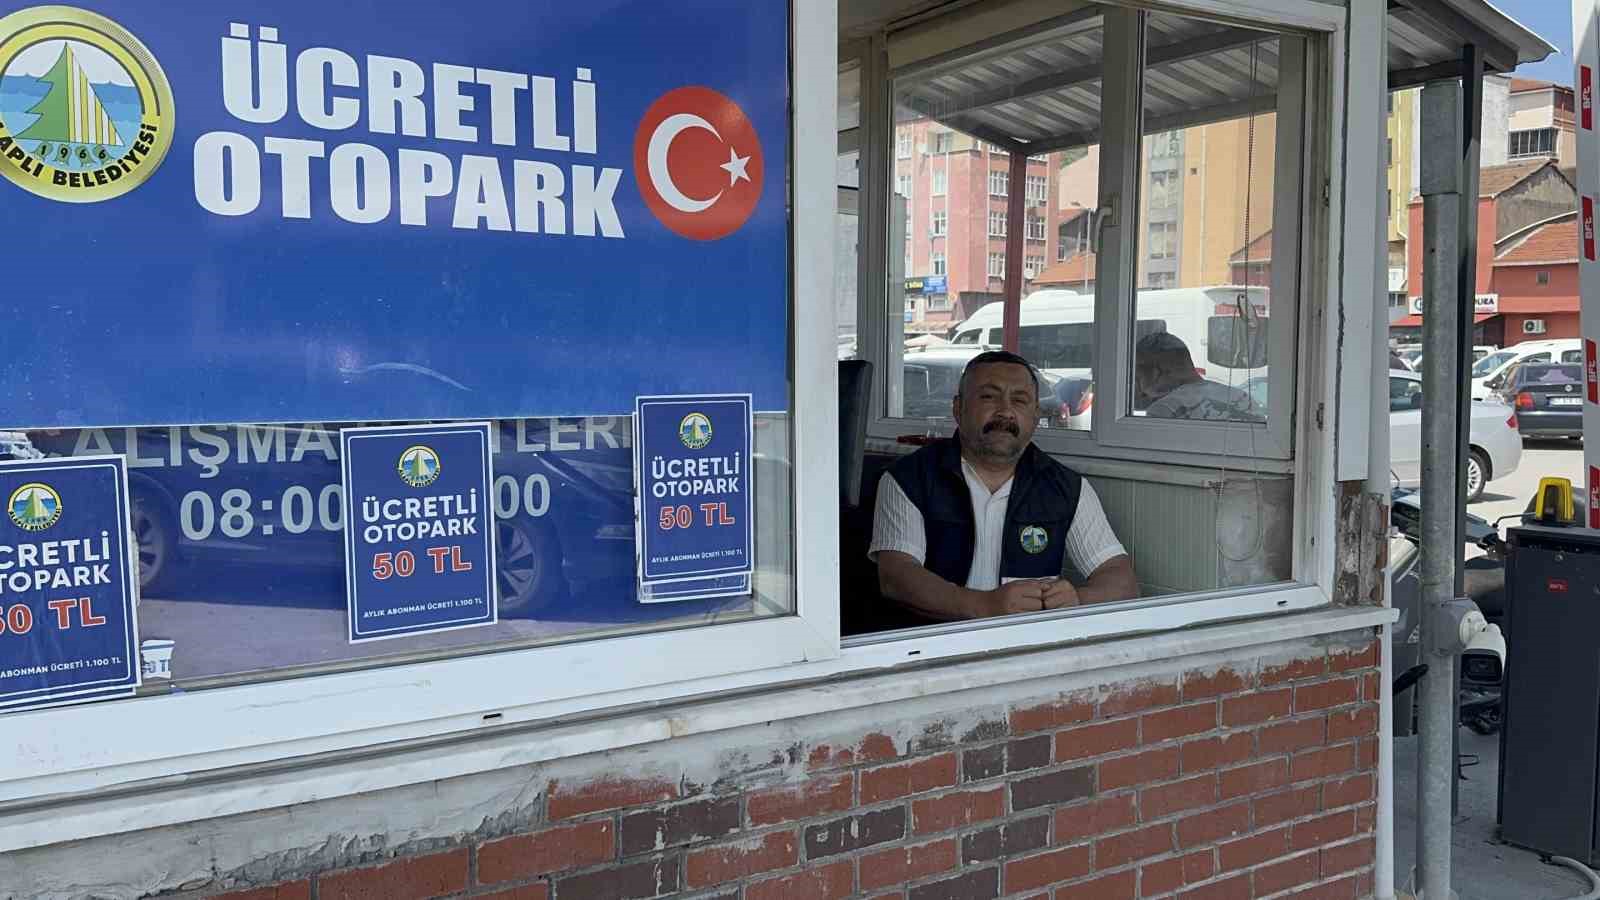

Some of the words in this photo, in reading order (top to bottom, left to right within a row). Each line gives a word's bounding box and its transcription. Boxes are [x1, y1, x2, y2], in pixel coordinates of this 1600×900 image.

[221, 22, 597, 154] ÜCRETLİ
[0, 123, 44, 177] APLI
[52, 123, 157, 188] BELEDİYESİ
[42, 145, 106, 159] 1966
[193, 131, 625, 239] OTOPARK
[652, 451, 740, 479] ÜCRETLİ
[652, 477, 740, 498] OTOPARK
[179, 484, 343, 541] 08:00
[363, 488, 477, 523] ÜCRETLİ
[660, 504, 693, 530] 50
[700, 502, 736, 527] TL
[363, 517, 478, 544] OTOPARK
[373, 550, 415, 580] 50
[427, 546, 473, 573] TL
[0, 603, 33, 635] 0
[47, 597, 106, 630] TL
[0, 665, 49, 679] ABONMAN
[50, 659, 84, 672] ÜCRETİ
[86, 658, 110, 669] 1.100
[111, 657, 122, 665] TL
